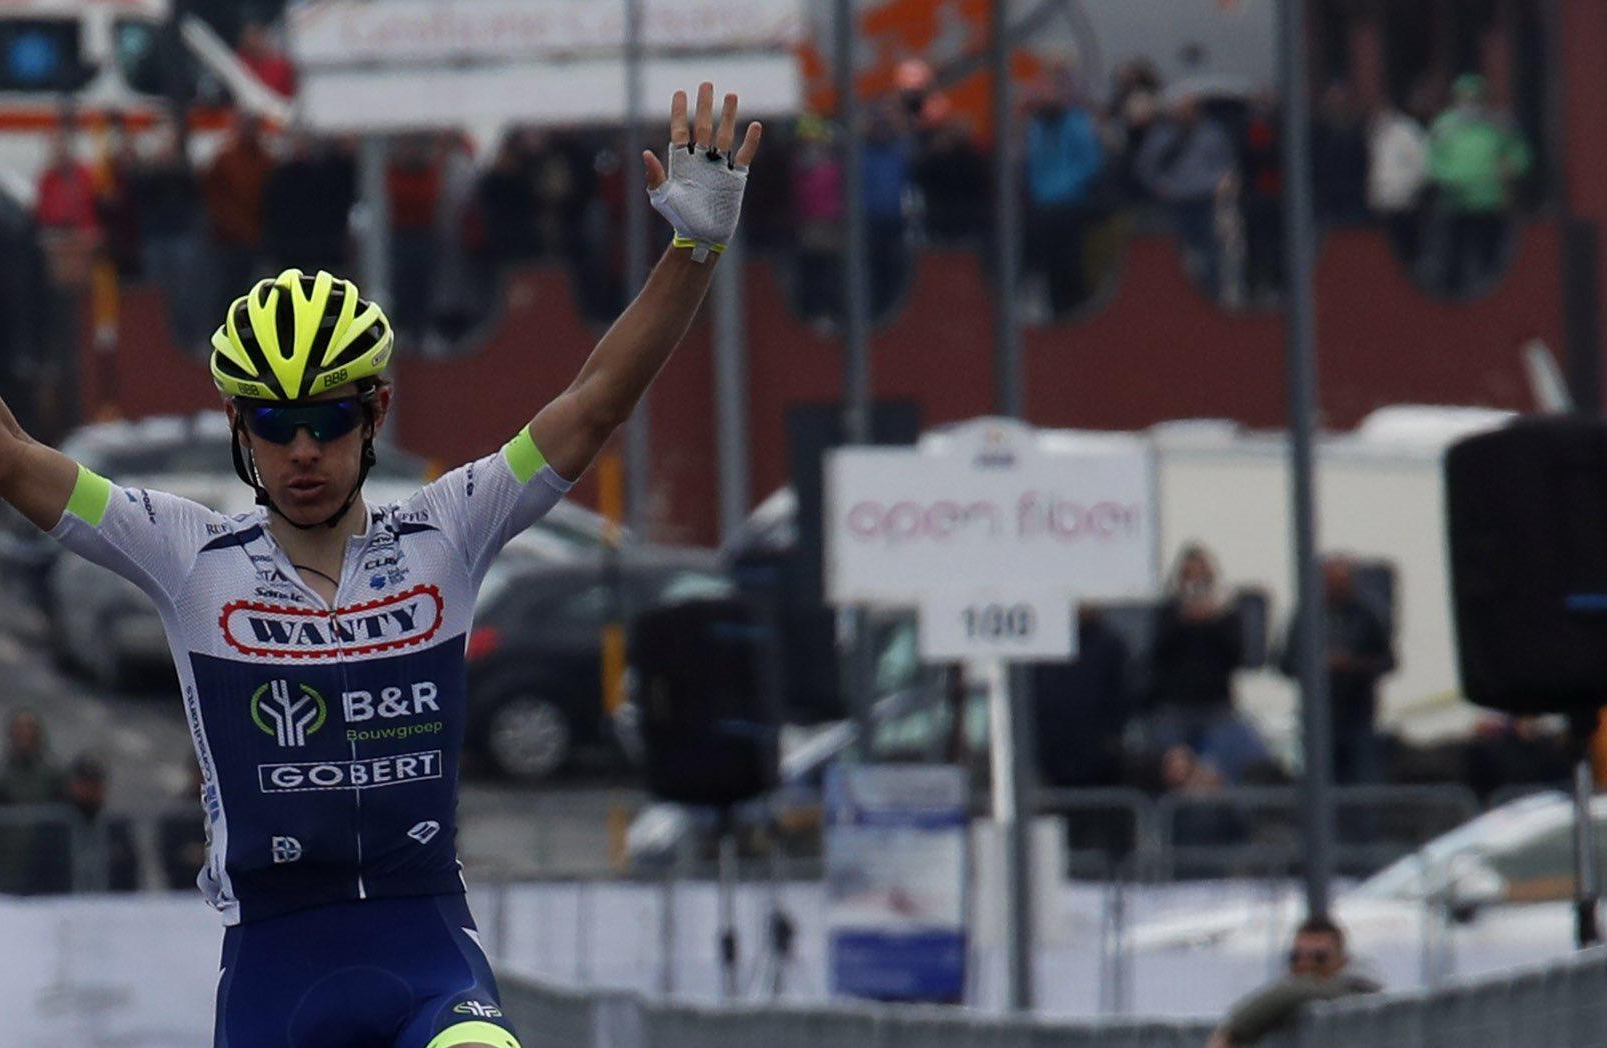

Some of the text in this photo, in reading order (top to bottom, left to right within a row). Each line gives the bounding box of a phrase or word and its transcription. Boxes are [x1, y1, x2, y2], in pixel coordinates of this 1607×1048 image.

[237, 383, 260, 396] BBB
[324, 368, 349, 387] BBB
[248, 602, 418, 645] WANTY
[963, 604, 1038, 643] 100
[343, 681, 441, 723] B&R
[347, 721, 443, 741] Bouwgroep
[271, 754, 435, 788] GOBERT
